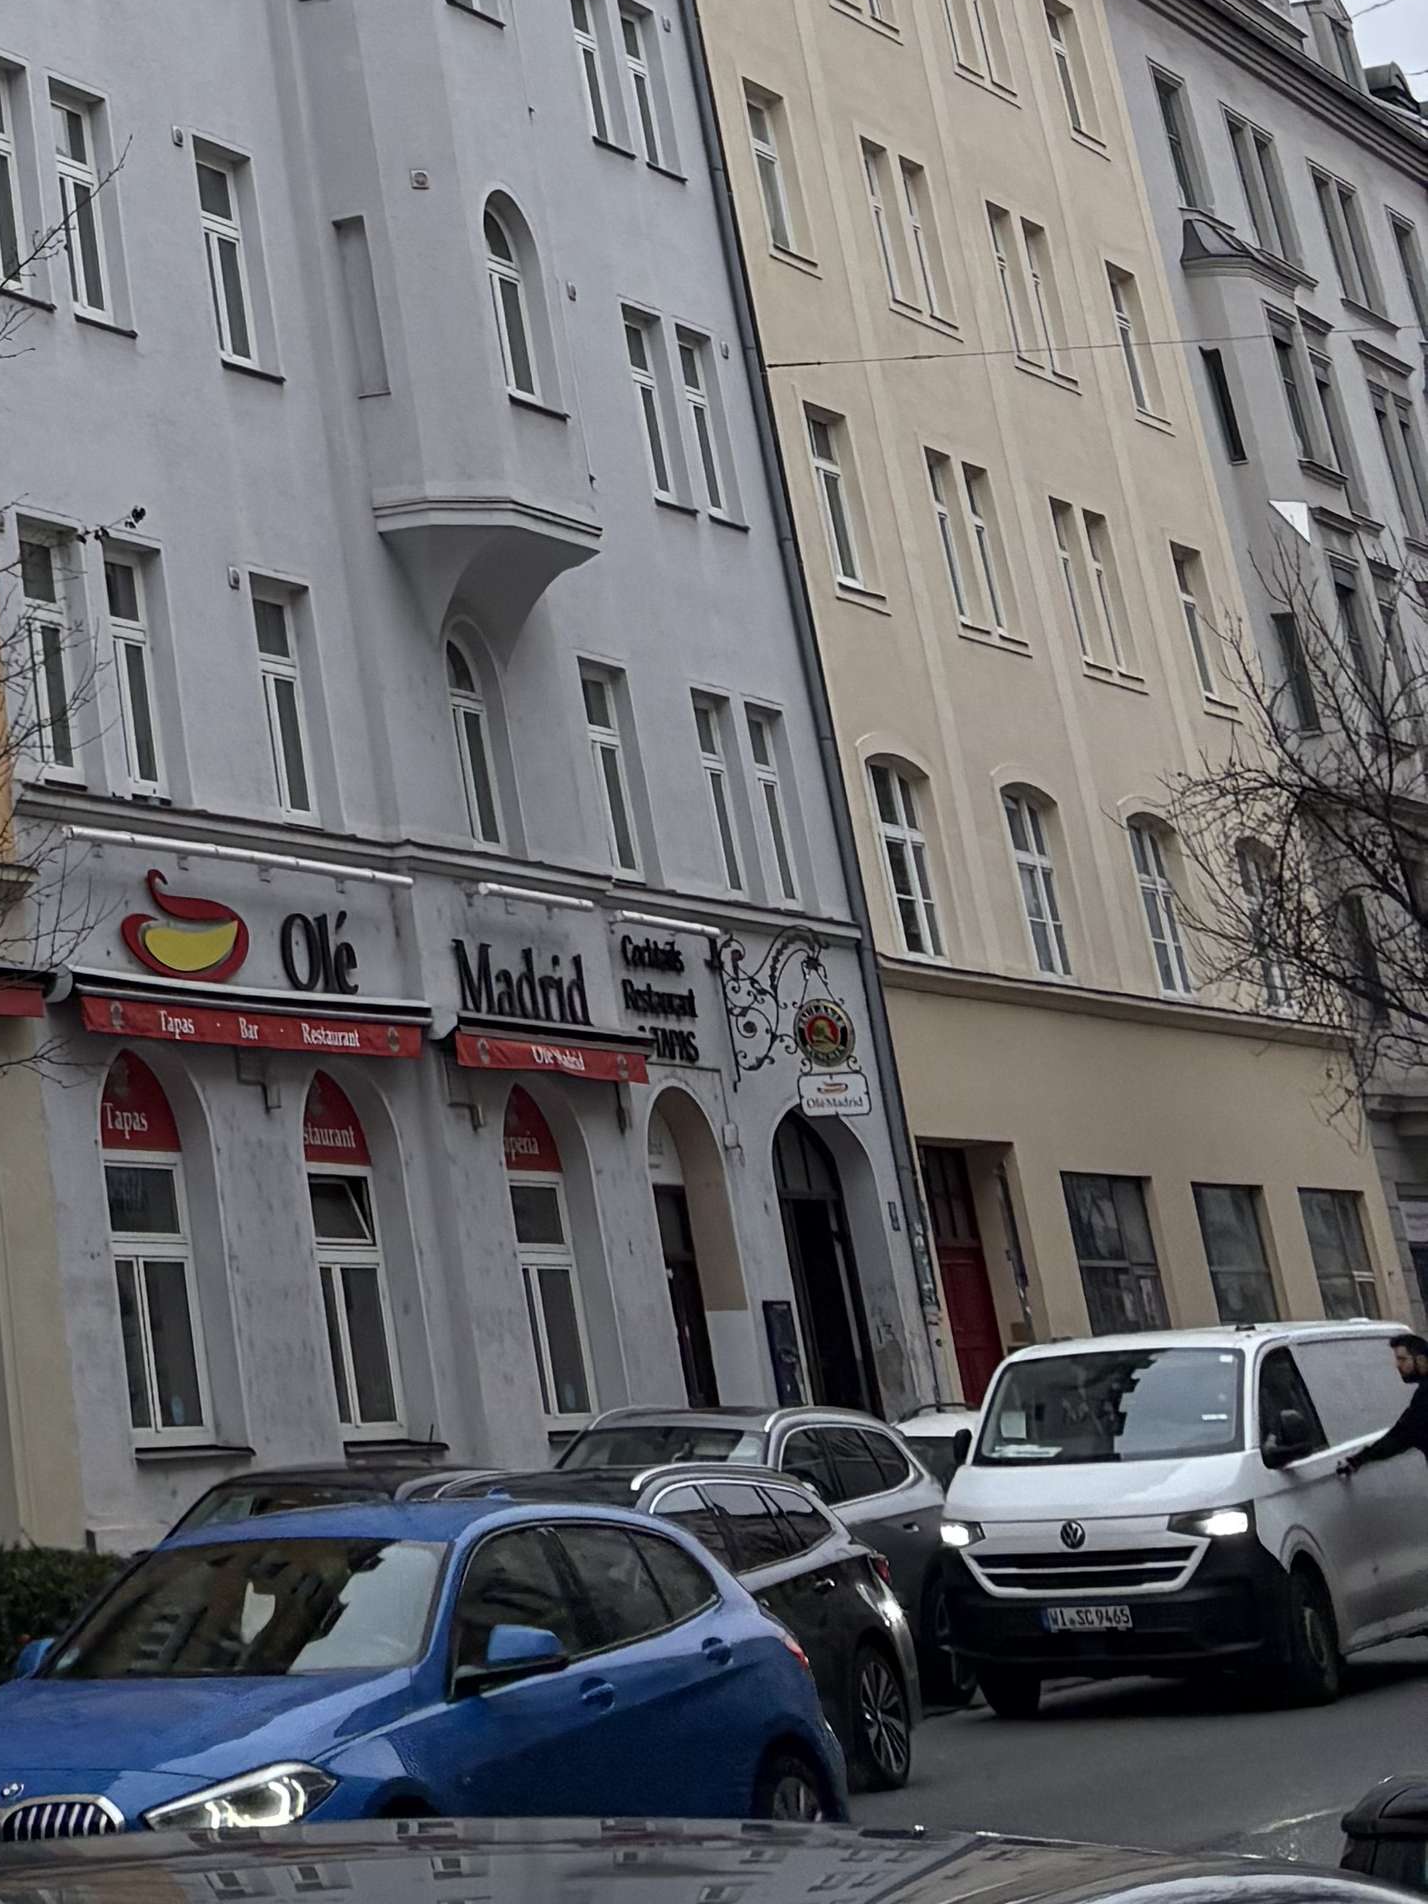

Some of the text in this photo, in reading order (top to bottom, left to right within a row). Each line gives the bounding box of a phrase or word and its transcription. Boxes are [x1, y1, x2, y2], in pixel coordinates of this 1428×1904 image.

[280, 909, 360, 995] Olé
[451, 938, 594, 1026] Madrid
[159, 1009, 195, 1041] Tapas
[238, 1017, 259, 1041] Bar
[301, 1022, 361, 1048] Restaurant
[103, 1102, 149, 1141] Tapas
[304, 1122, 356, 1148] staurant
